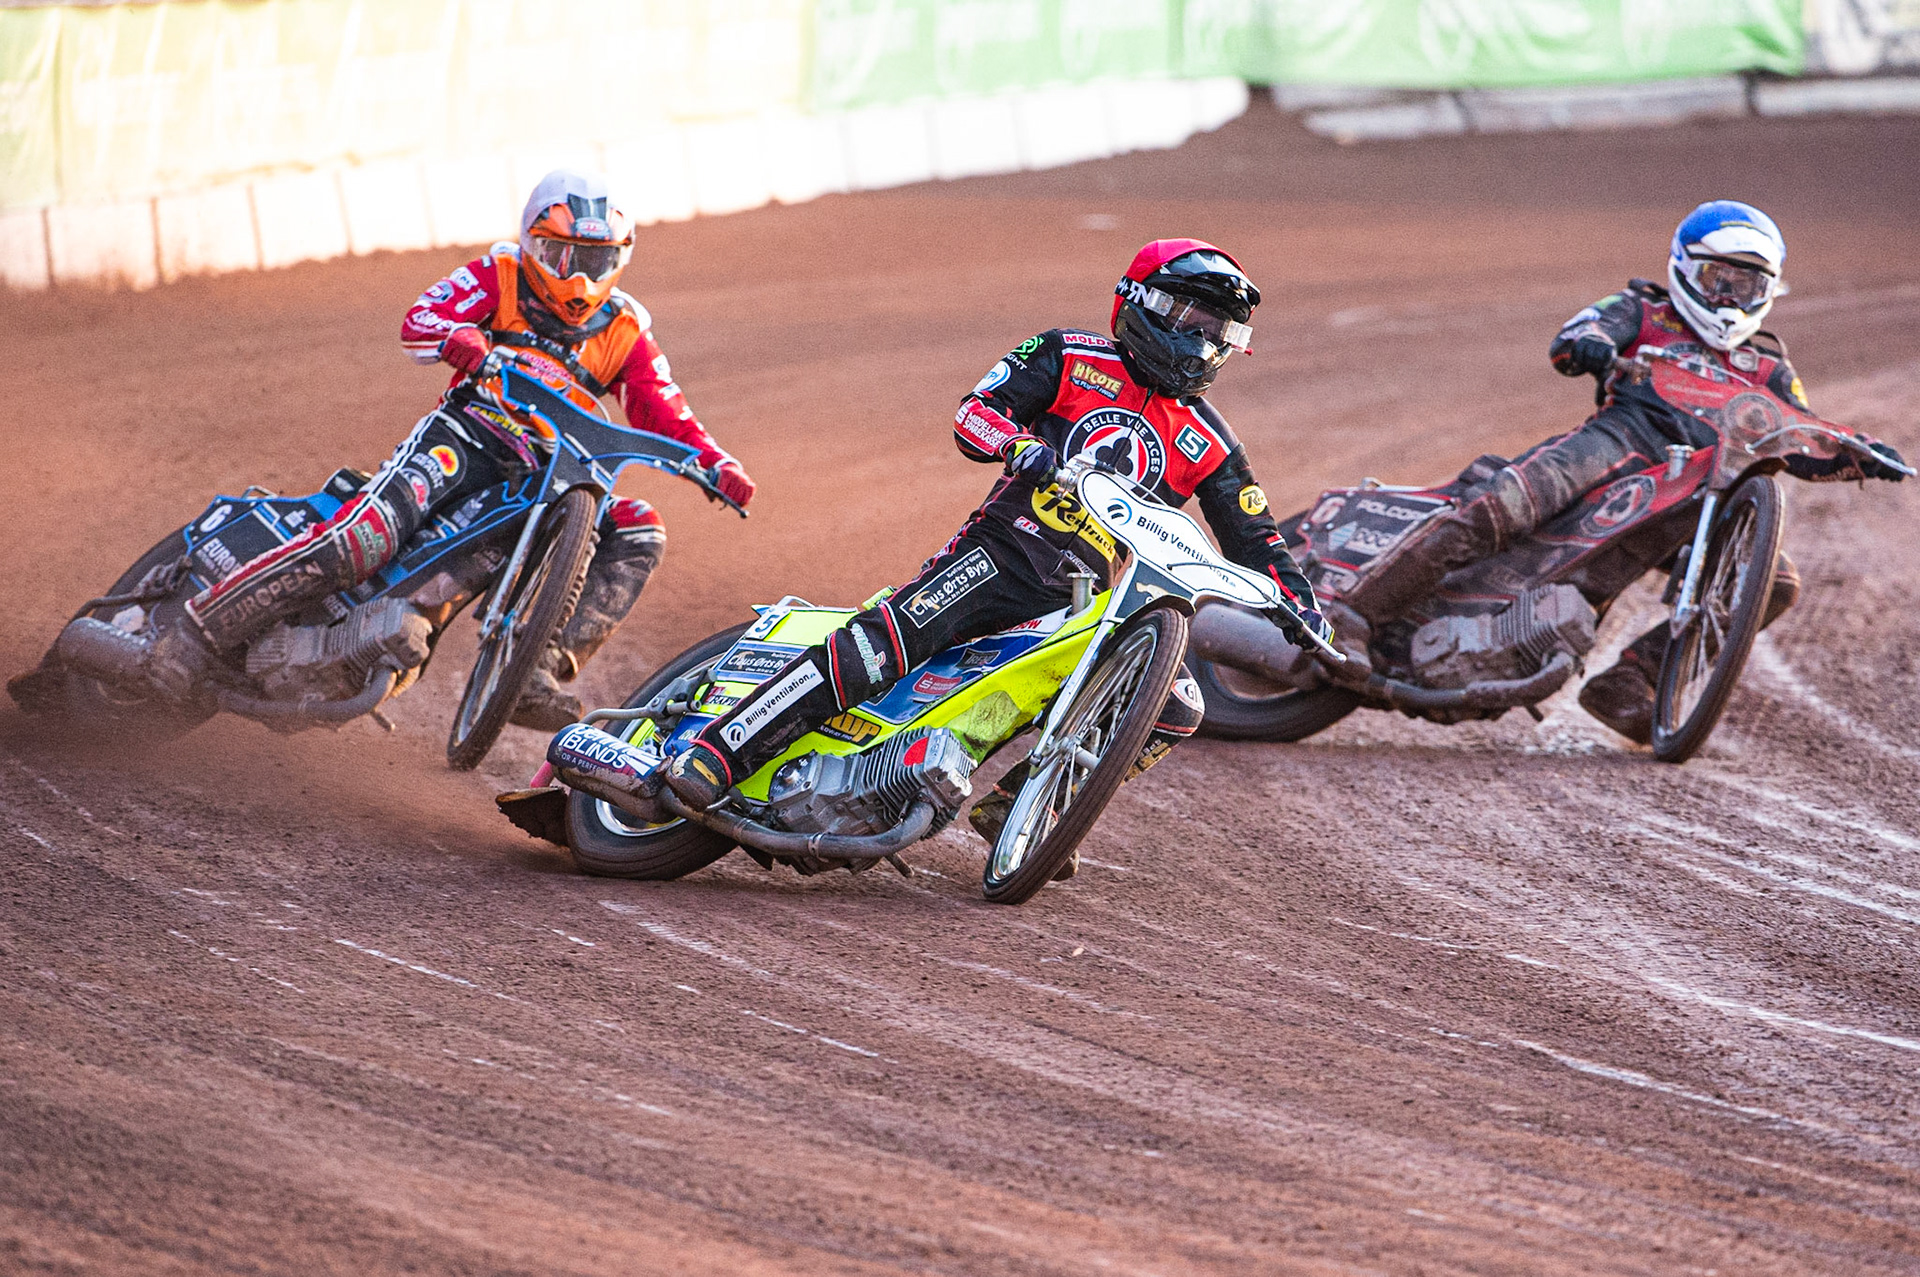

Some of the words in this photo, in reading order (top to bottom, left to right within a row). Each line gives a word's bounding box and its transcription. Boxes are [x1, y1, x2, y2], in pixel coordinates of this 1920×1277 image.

[1065, 335, 1115, 349] MOLDO
[1073, 363, 1121, 392] HYCOTE
[963, 420, 1000, 448] SPAREKASSE
[967, 412, 1008, 442] MIDDELFART
[1082, 414, 1121, 433] BELLE
[1126, 417, 1149, 437] VUE
[1146, 441, 1160, 474] ACES
[1181, 431, 1204, 456] 5
[200, 504, 232, 532] 6
[1137, 516, 1169, 542] Billig
[203, 537, 241, 573] EURO
[913, 590, 945, 615] Claus
[943, 573, 968, 595] Ørts
[965, 560, 989, 578] Byg
[755, 614, 780, 633] 5
[745, 706, 767, 726] Billig
[563, 734, 627, 769] BLINDS
